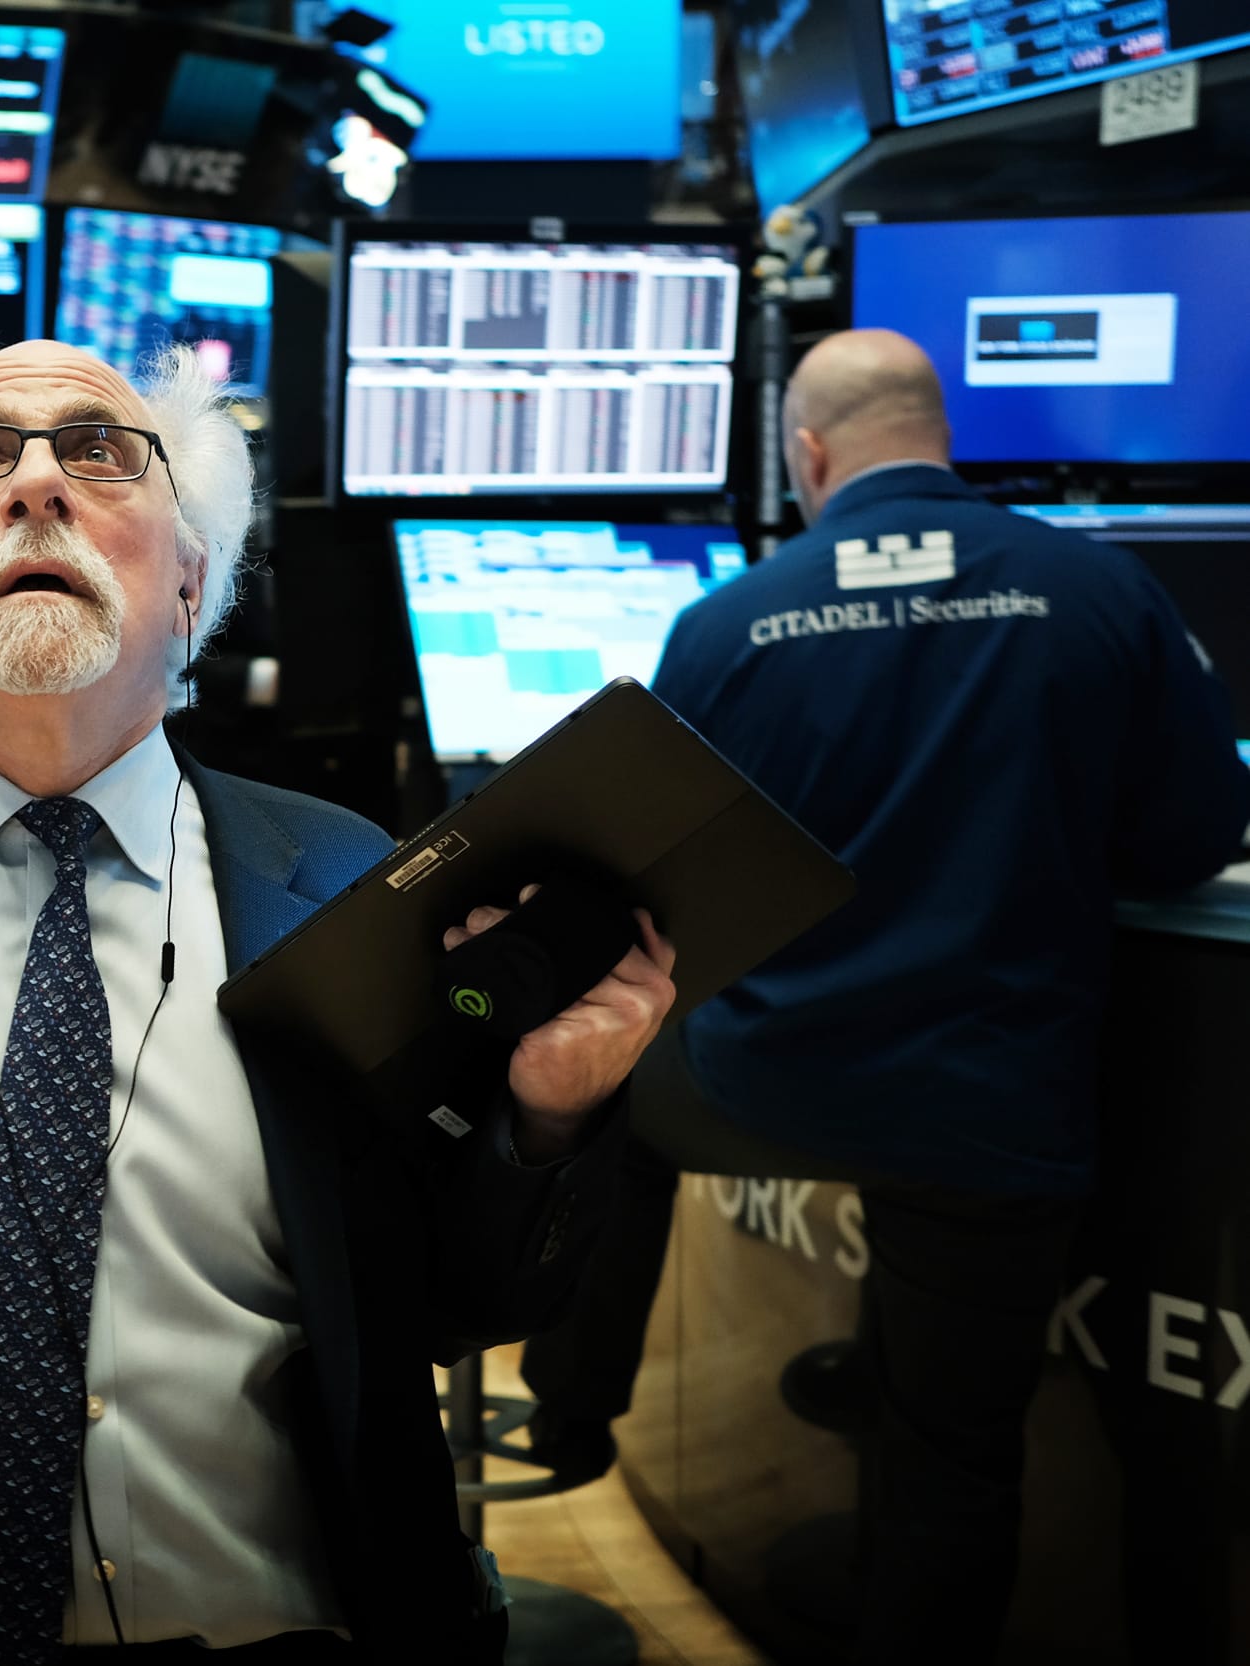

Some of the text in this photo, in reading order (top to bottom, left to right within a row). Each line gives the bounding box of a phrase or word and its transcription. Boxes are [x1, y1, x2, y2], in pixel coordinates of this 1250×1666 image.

[464, 19, 605, 56] LISTED
[138, 143, 245, 195] NYSE
[750, 588, 1049, 645] CITADEL Securities
[692, 1172, 817, 1262] ORK
